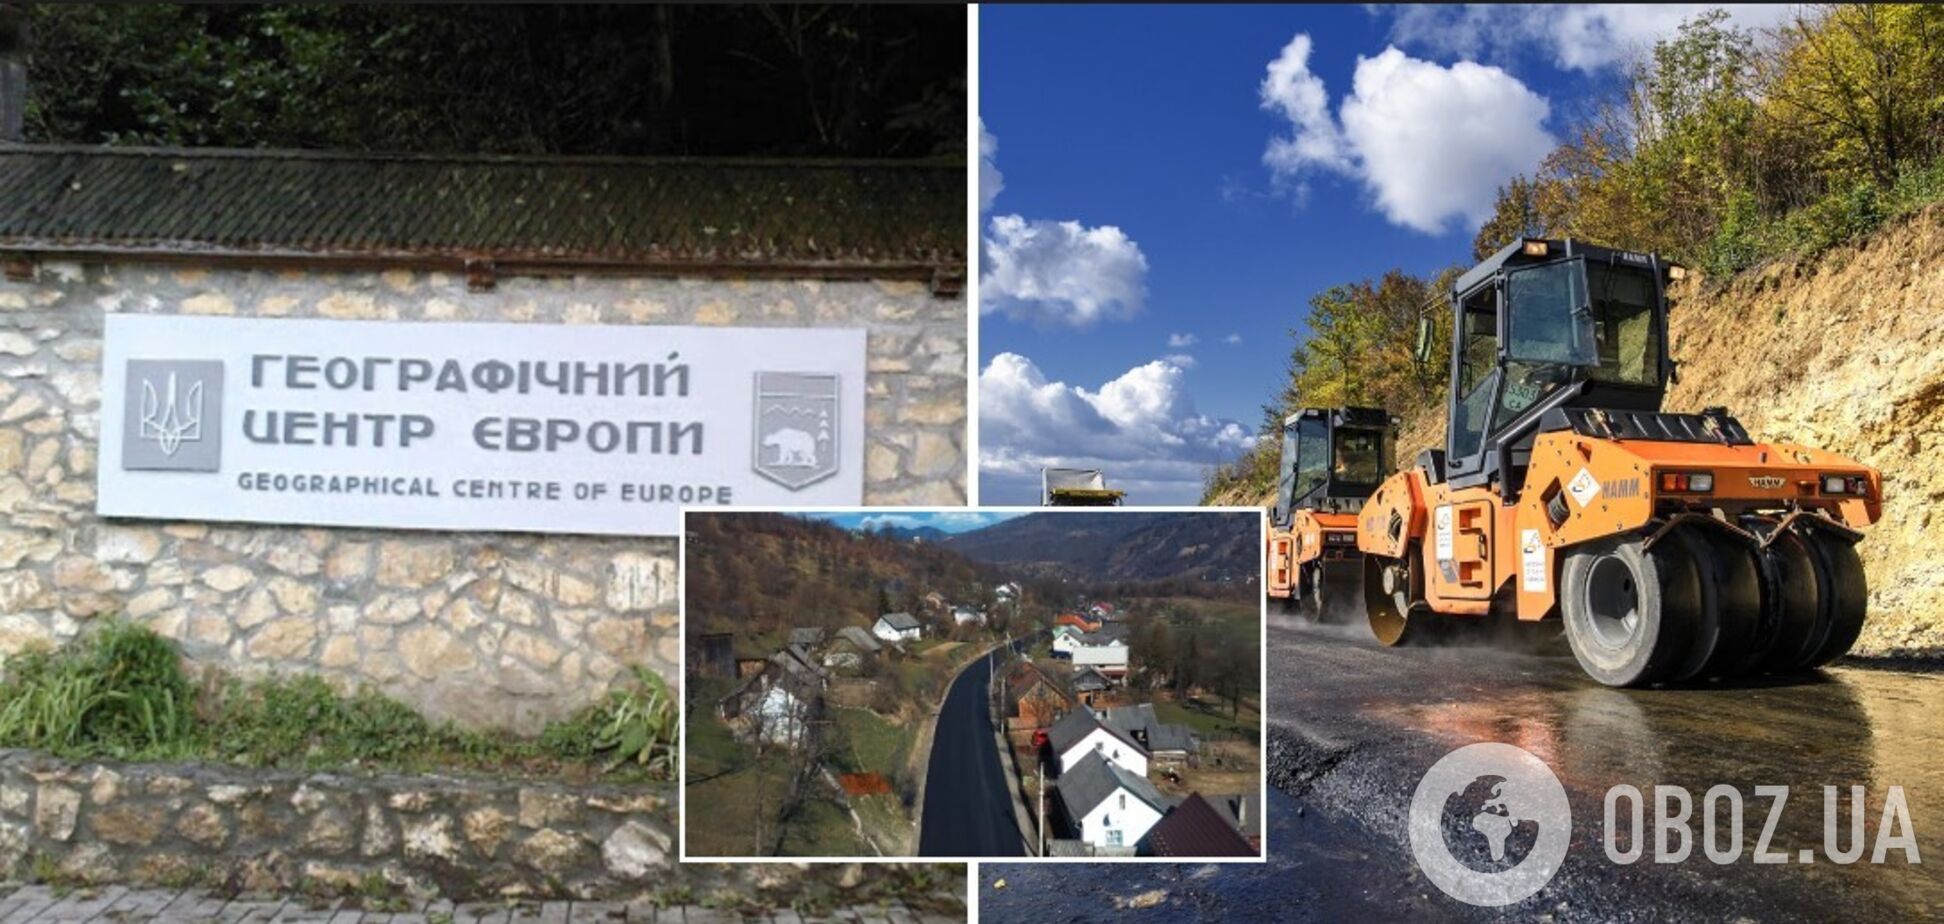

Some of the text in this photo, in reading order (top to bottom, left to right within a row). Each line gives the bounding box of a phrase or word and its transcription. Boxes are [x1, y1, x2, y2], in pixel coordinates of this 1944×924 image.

[250, 352, 690, 397] ГЕОГРАФІЧНИЙ
[241, 409, 705, 456] ЦЕНТР ЄВРОПИ
[237, 471, 734, 506] GEOGRAPHICAL CENTRE OF EUROPE
[1602, 478, 1639, 499] HAMM
